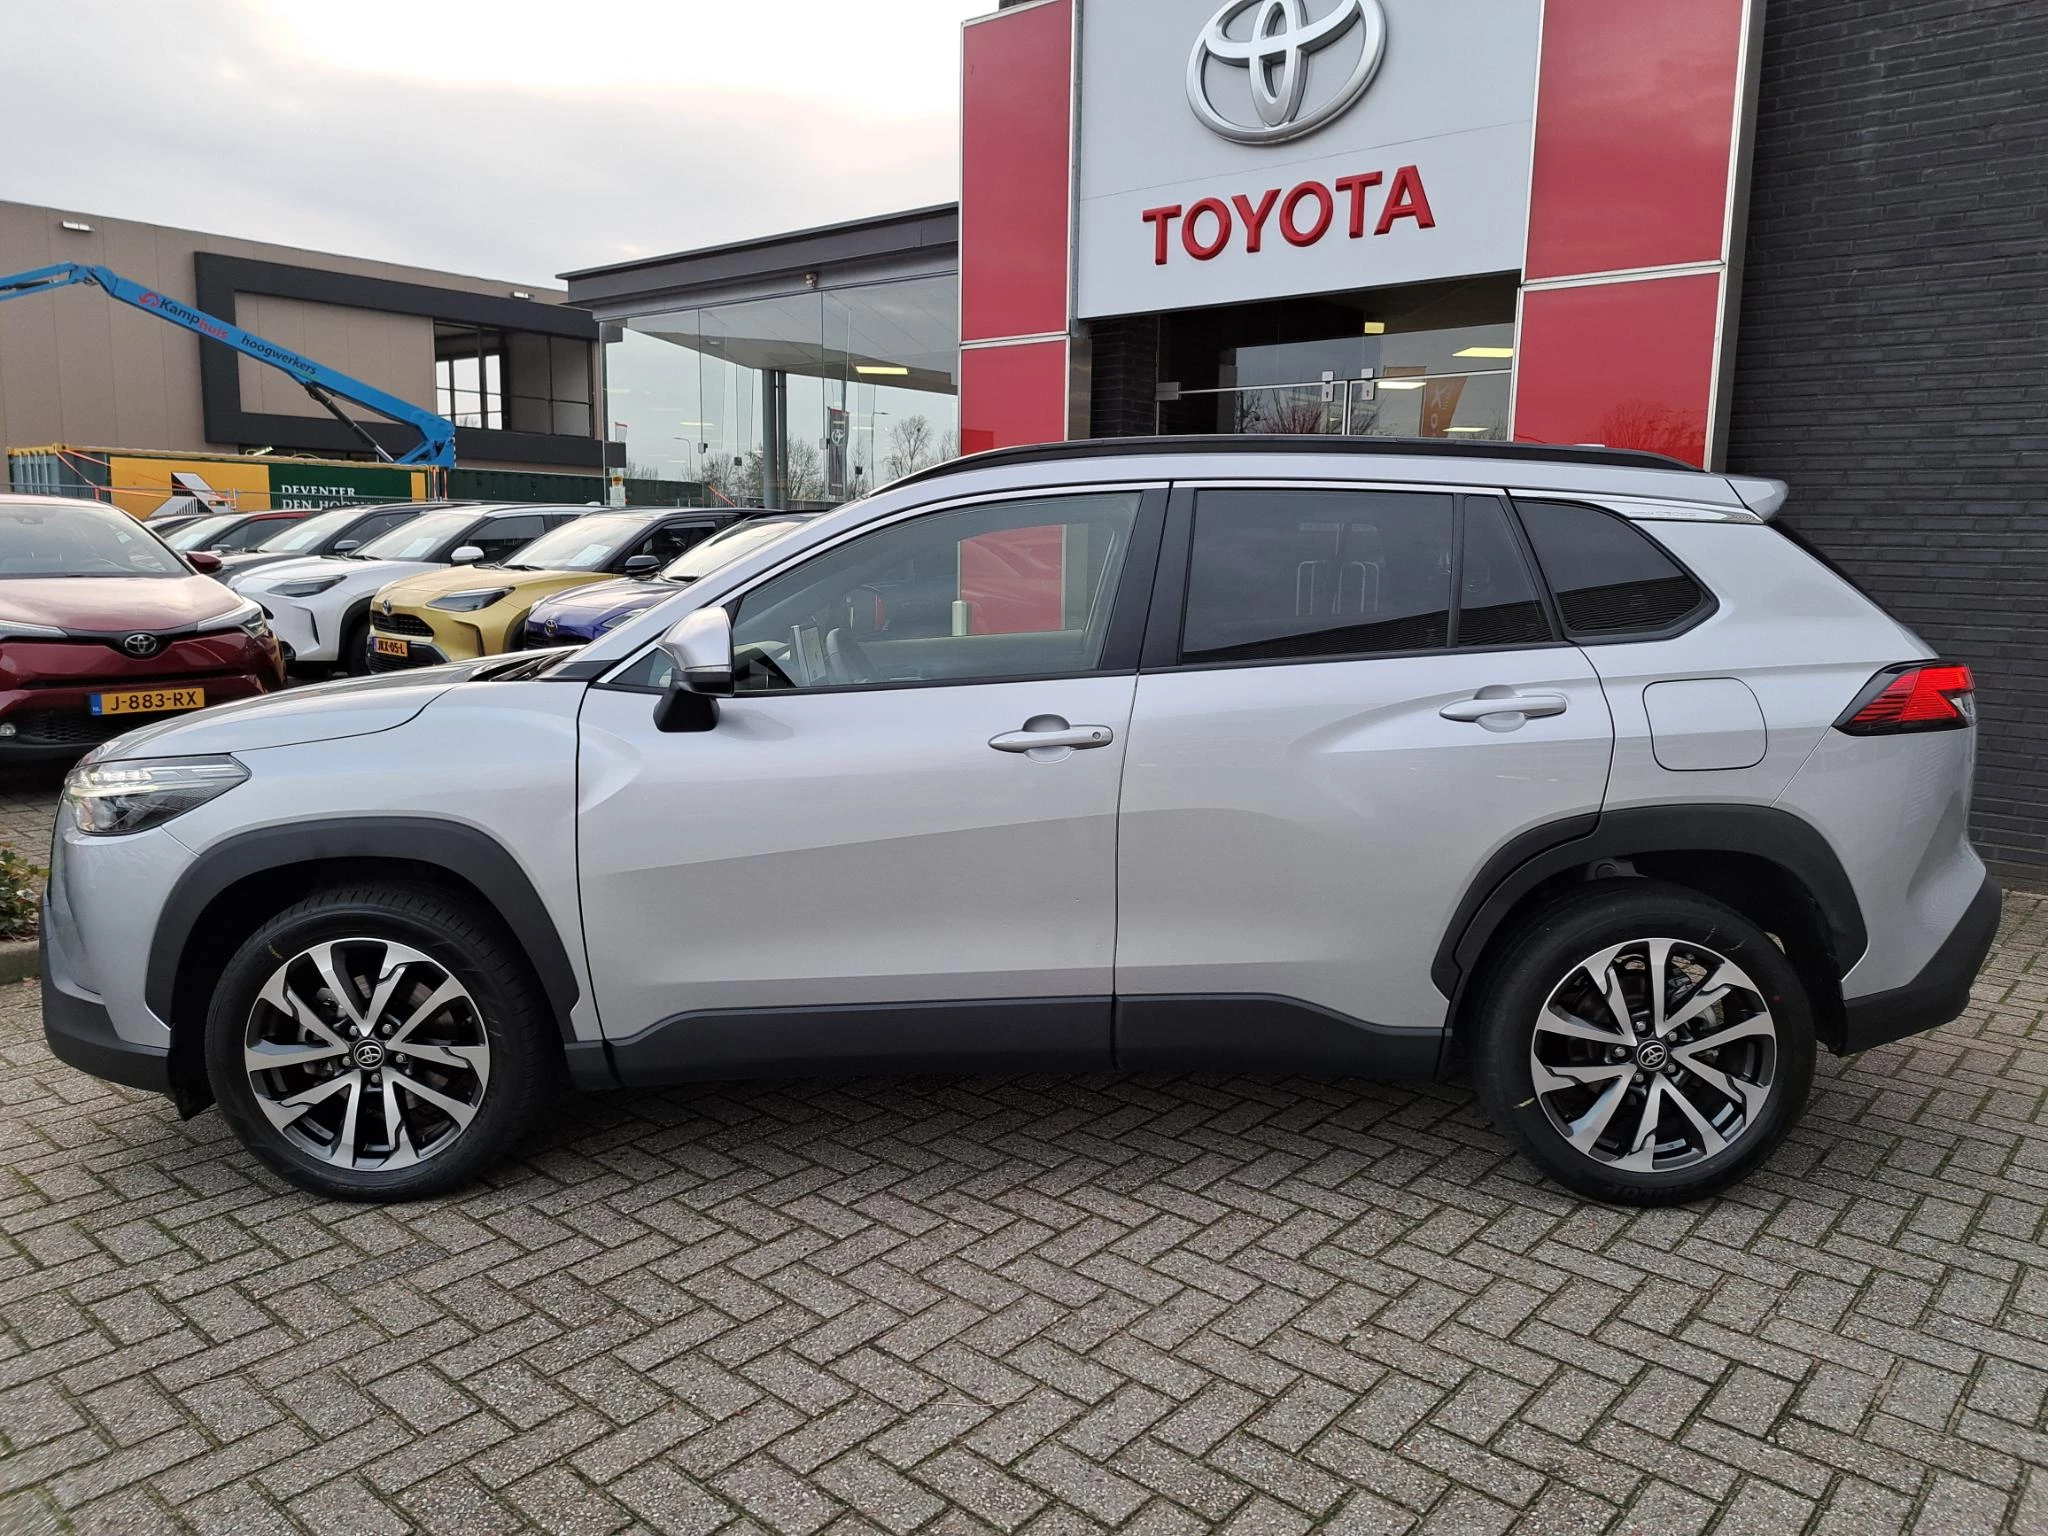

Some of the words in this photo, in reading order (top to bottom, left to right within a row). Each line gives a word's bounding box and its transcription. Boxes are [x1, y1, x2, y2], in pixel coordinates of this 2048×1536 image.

[1142, 165, 1436, 266] TOYOTA
[159, 298, 229, 340] Kamphuis
[240, 335, 318, 375] hoogwerkers
[281, 484, 356, 497] DEVENTER
[282, 499, 312, 510] DEN
[110, 691, 197, 711] J-883-RX
